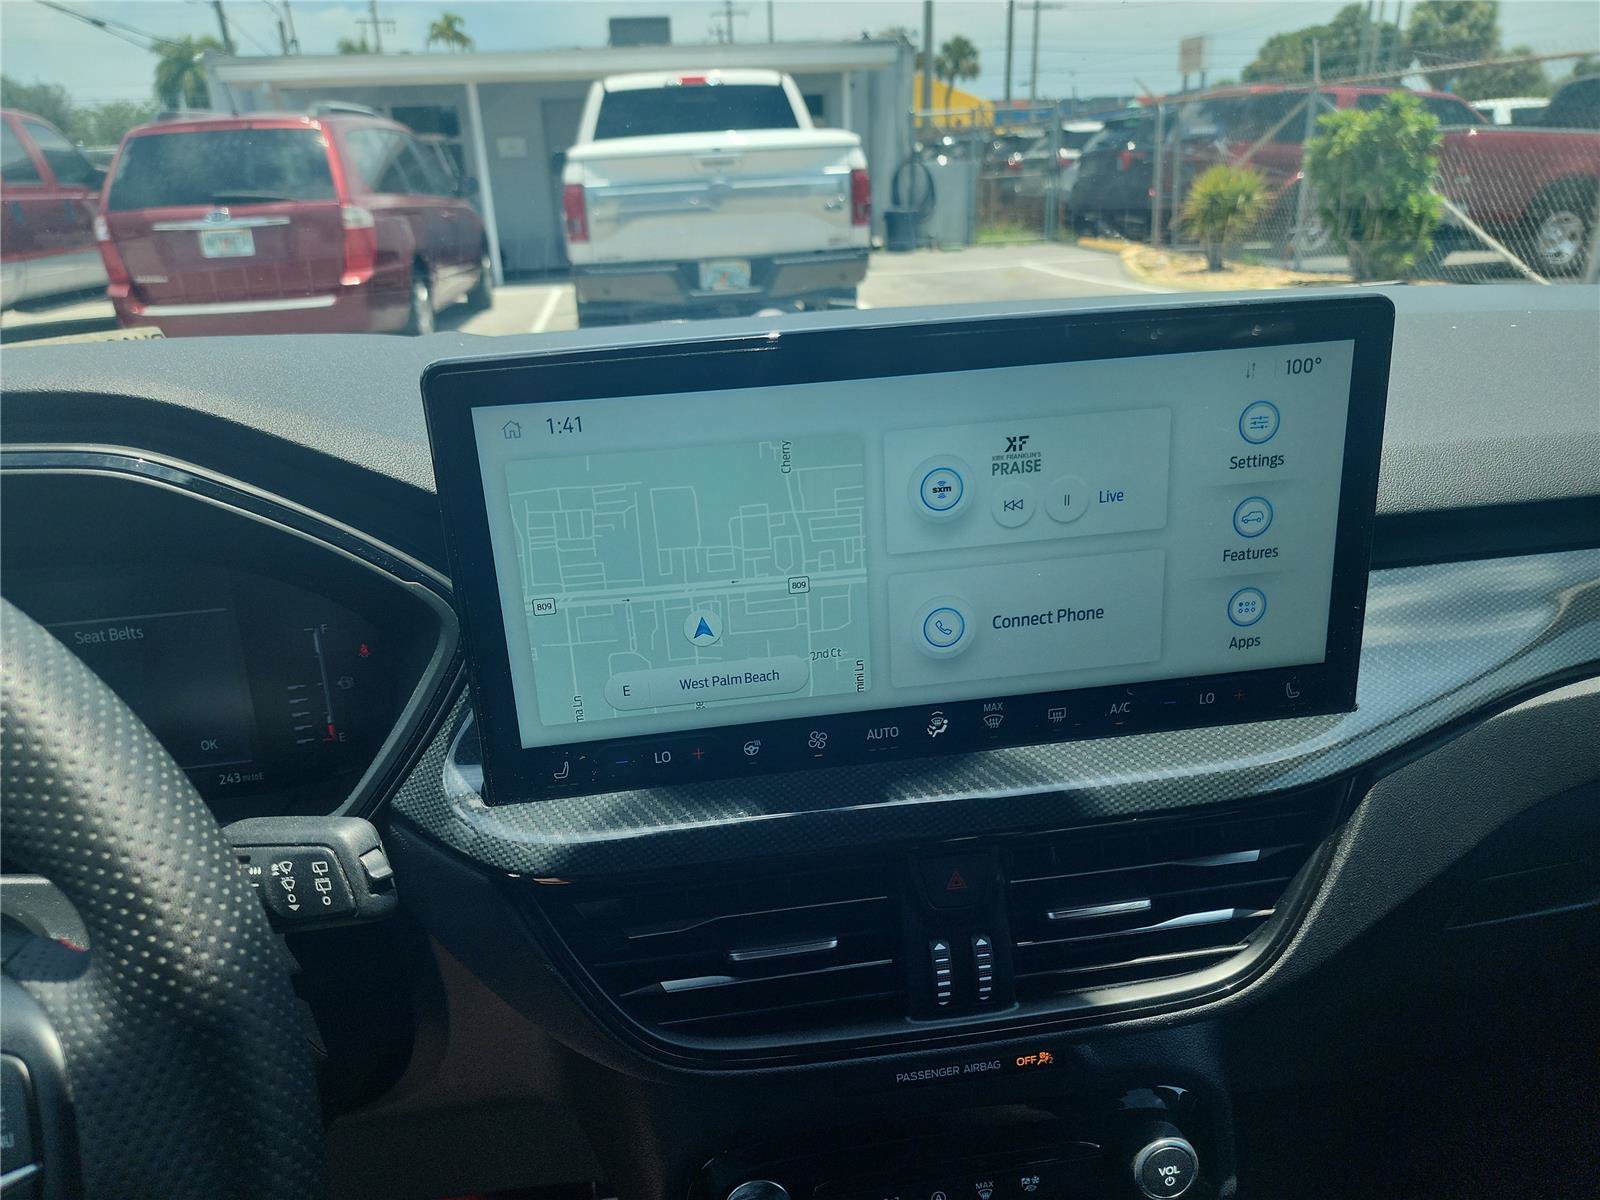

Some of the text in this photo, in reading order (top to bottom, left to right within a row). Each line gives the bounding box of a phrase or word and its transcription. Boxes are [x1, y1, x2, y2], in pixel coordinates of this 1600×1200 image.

[546, 416, 583, 435] 1:41
[781, 439, 792, 474] Cherry
[1229, 452, 1285, 471] Settings
[991, 459, 1042, 476] PRAISE
[932, 484, 952, 495] sxm
[1099, 488, 1124, 504] Live
[1222, 545, 1279, 563] Features
[791, 580, 807, 591] 809
[536, 601, 553, 613] 809
[992, 606, 1105, 630] Connect Phone
[74, 626, 144, 645] Seat Belts
[1229, 634, 1261, 650] Apps
[830, 648, 842, 658] Ct
[679, 670, 780, 690] West Palm Beach
[622, 685, 631, 697] E
[1199, 692, 1215, 706] LO
[983, 703, 1003, 713] MAX
[1109, 703, 1131, 716] A/C
[866, 726, 899, 741] AUTO
[200, 739, 218, 751] OK
[654, 751, 671, 764] LO
[219, 773, 241, 785] 243
[1016, 1055, 1037, 1066] OFF
[896, 1060, 1001, 1083] PASSENGER AIRBAG
[1158, 1165, 1180, 1177] VOL
[975, 1181, 994, 1190] MAX
